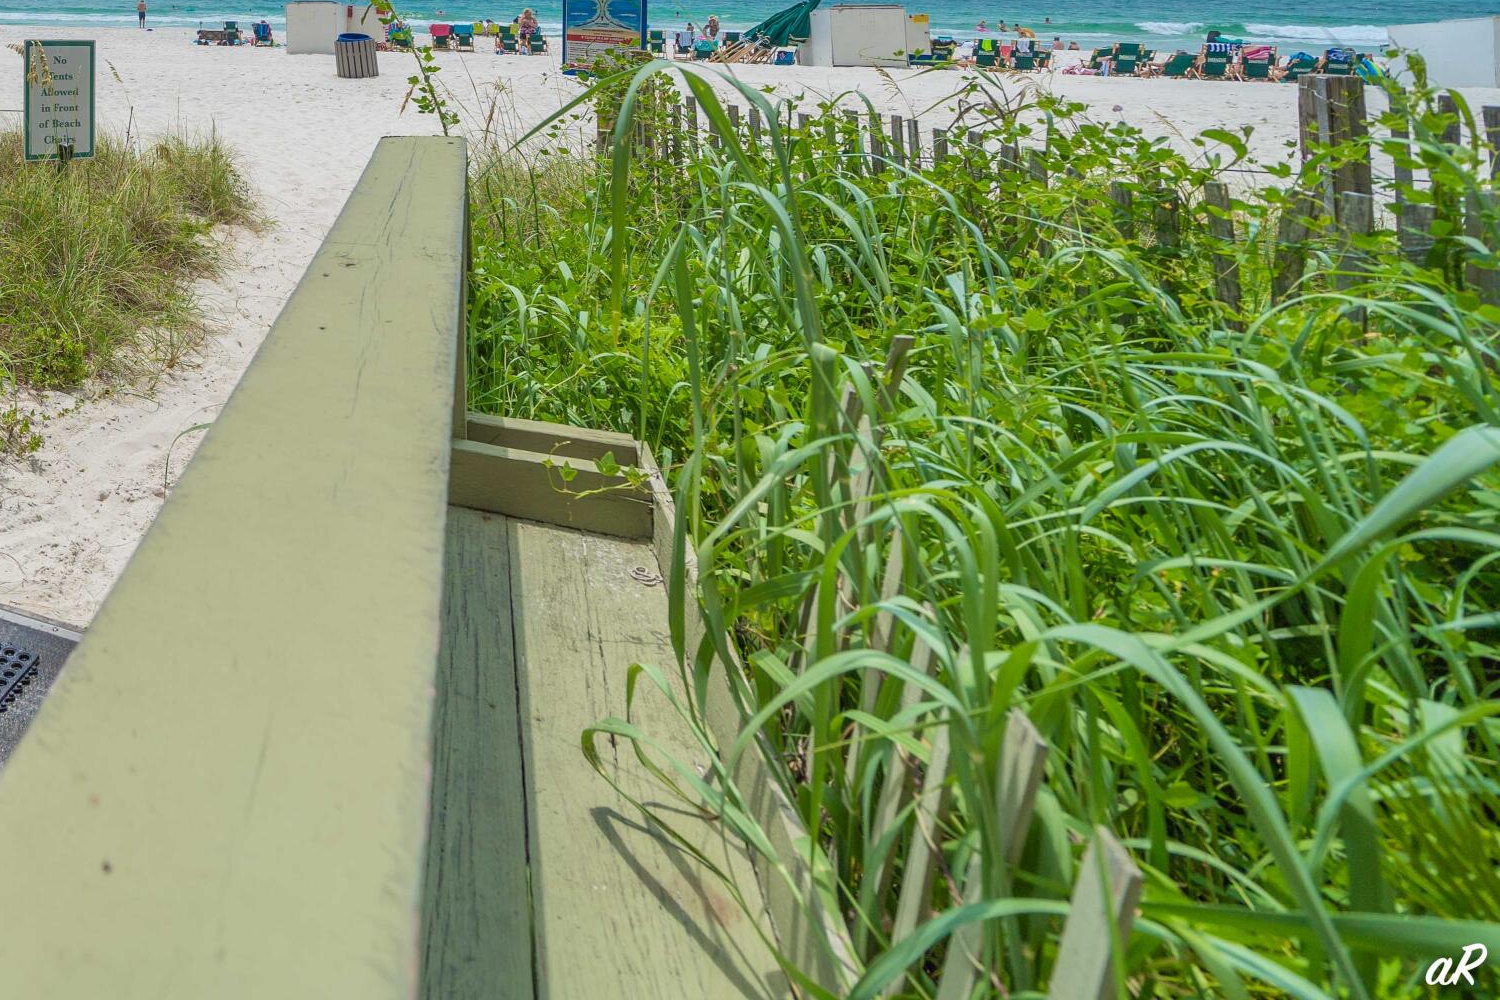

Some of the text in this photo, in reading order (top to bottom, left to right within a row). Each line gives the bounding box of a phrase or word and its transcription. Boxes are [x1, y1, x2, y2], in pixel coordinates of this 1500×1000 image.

[53, 55, 67, 65] No
[49, 71, 74, 81] Tents
[40, 87, 79, 97] Allowed
[41, 103, 79, 113] in Front
[38, 118, 81, 129] of Beach
[44, 134, 77, 144] Chairs
